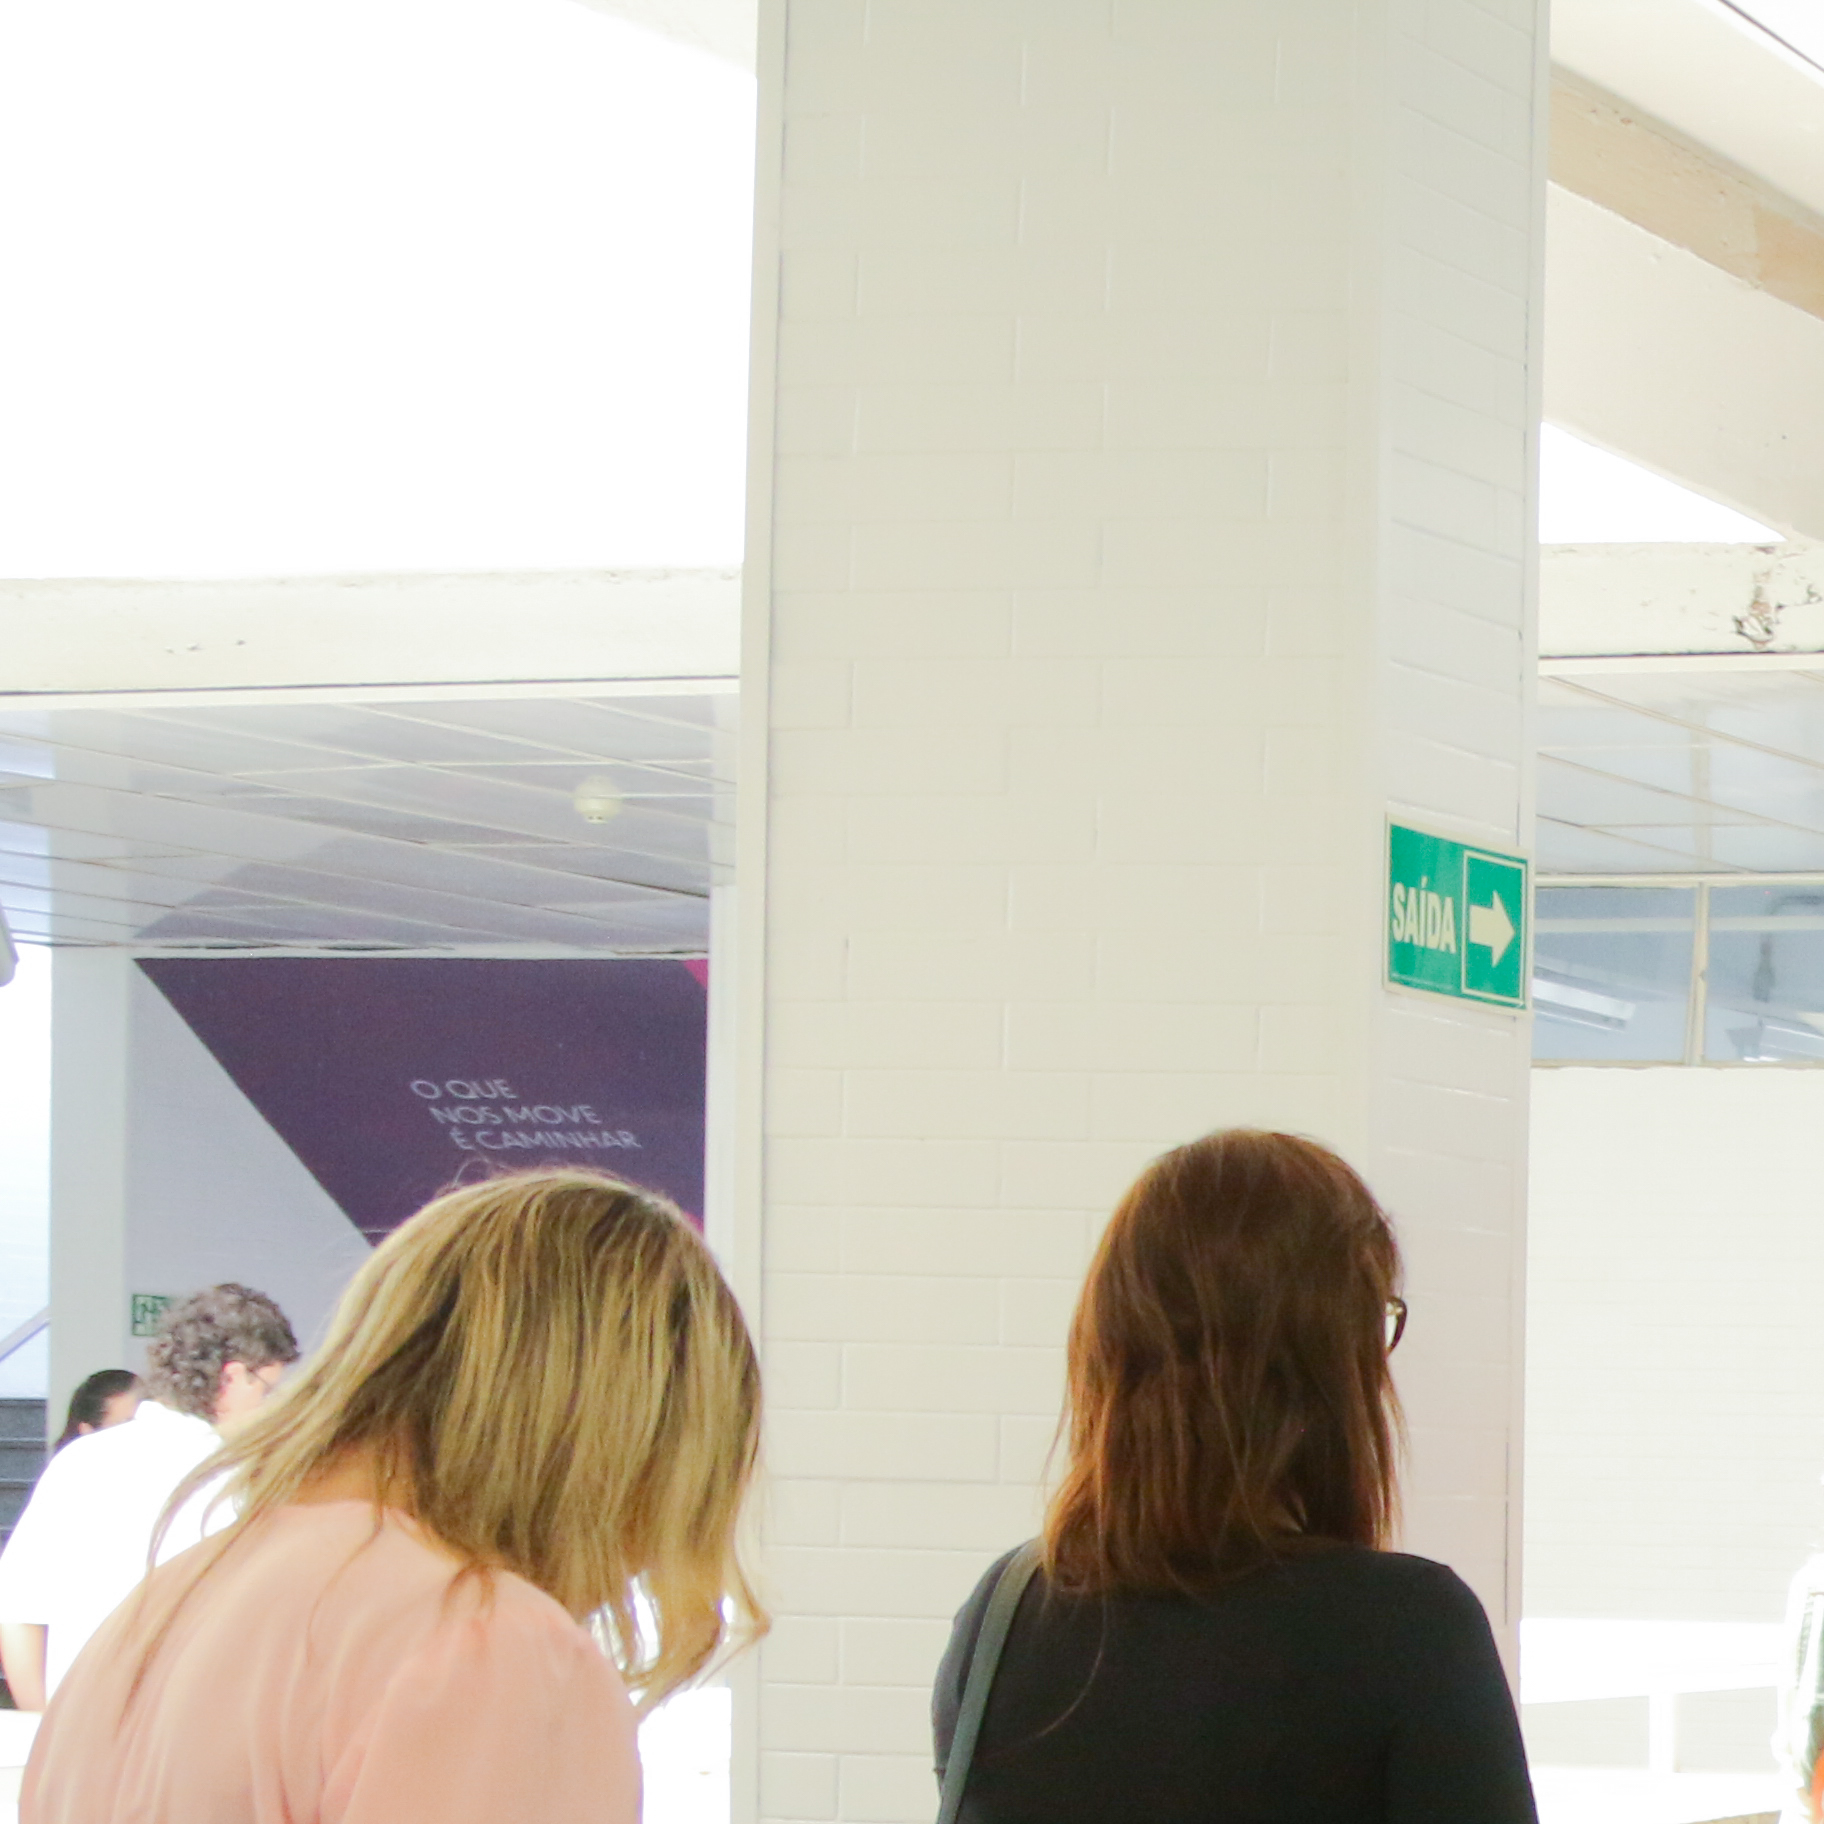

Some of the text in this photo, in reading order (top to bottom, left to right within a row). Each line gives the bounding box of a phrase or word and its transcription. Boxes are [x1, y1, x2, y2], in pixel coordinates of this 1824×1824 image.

[1393, 875, 1457, 954] SAÍDA
[410, 1079, 518, 1099] O QUE
[430, 1105, 602, 1125] NOS MOVE
[450, 1127, 642, 1150] É CAMINHAR
